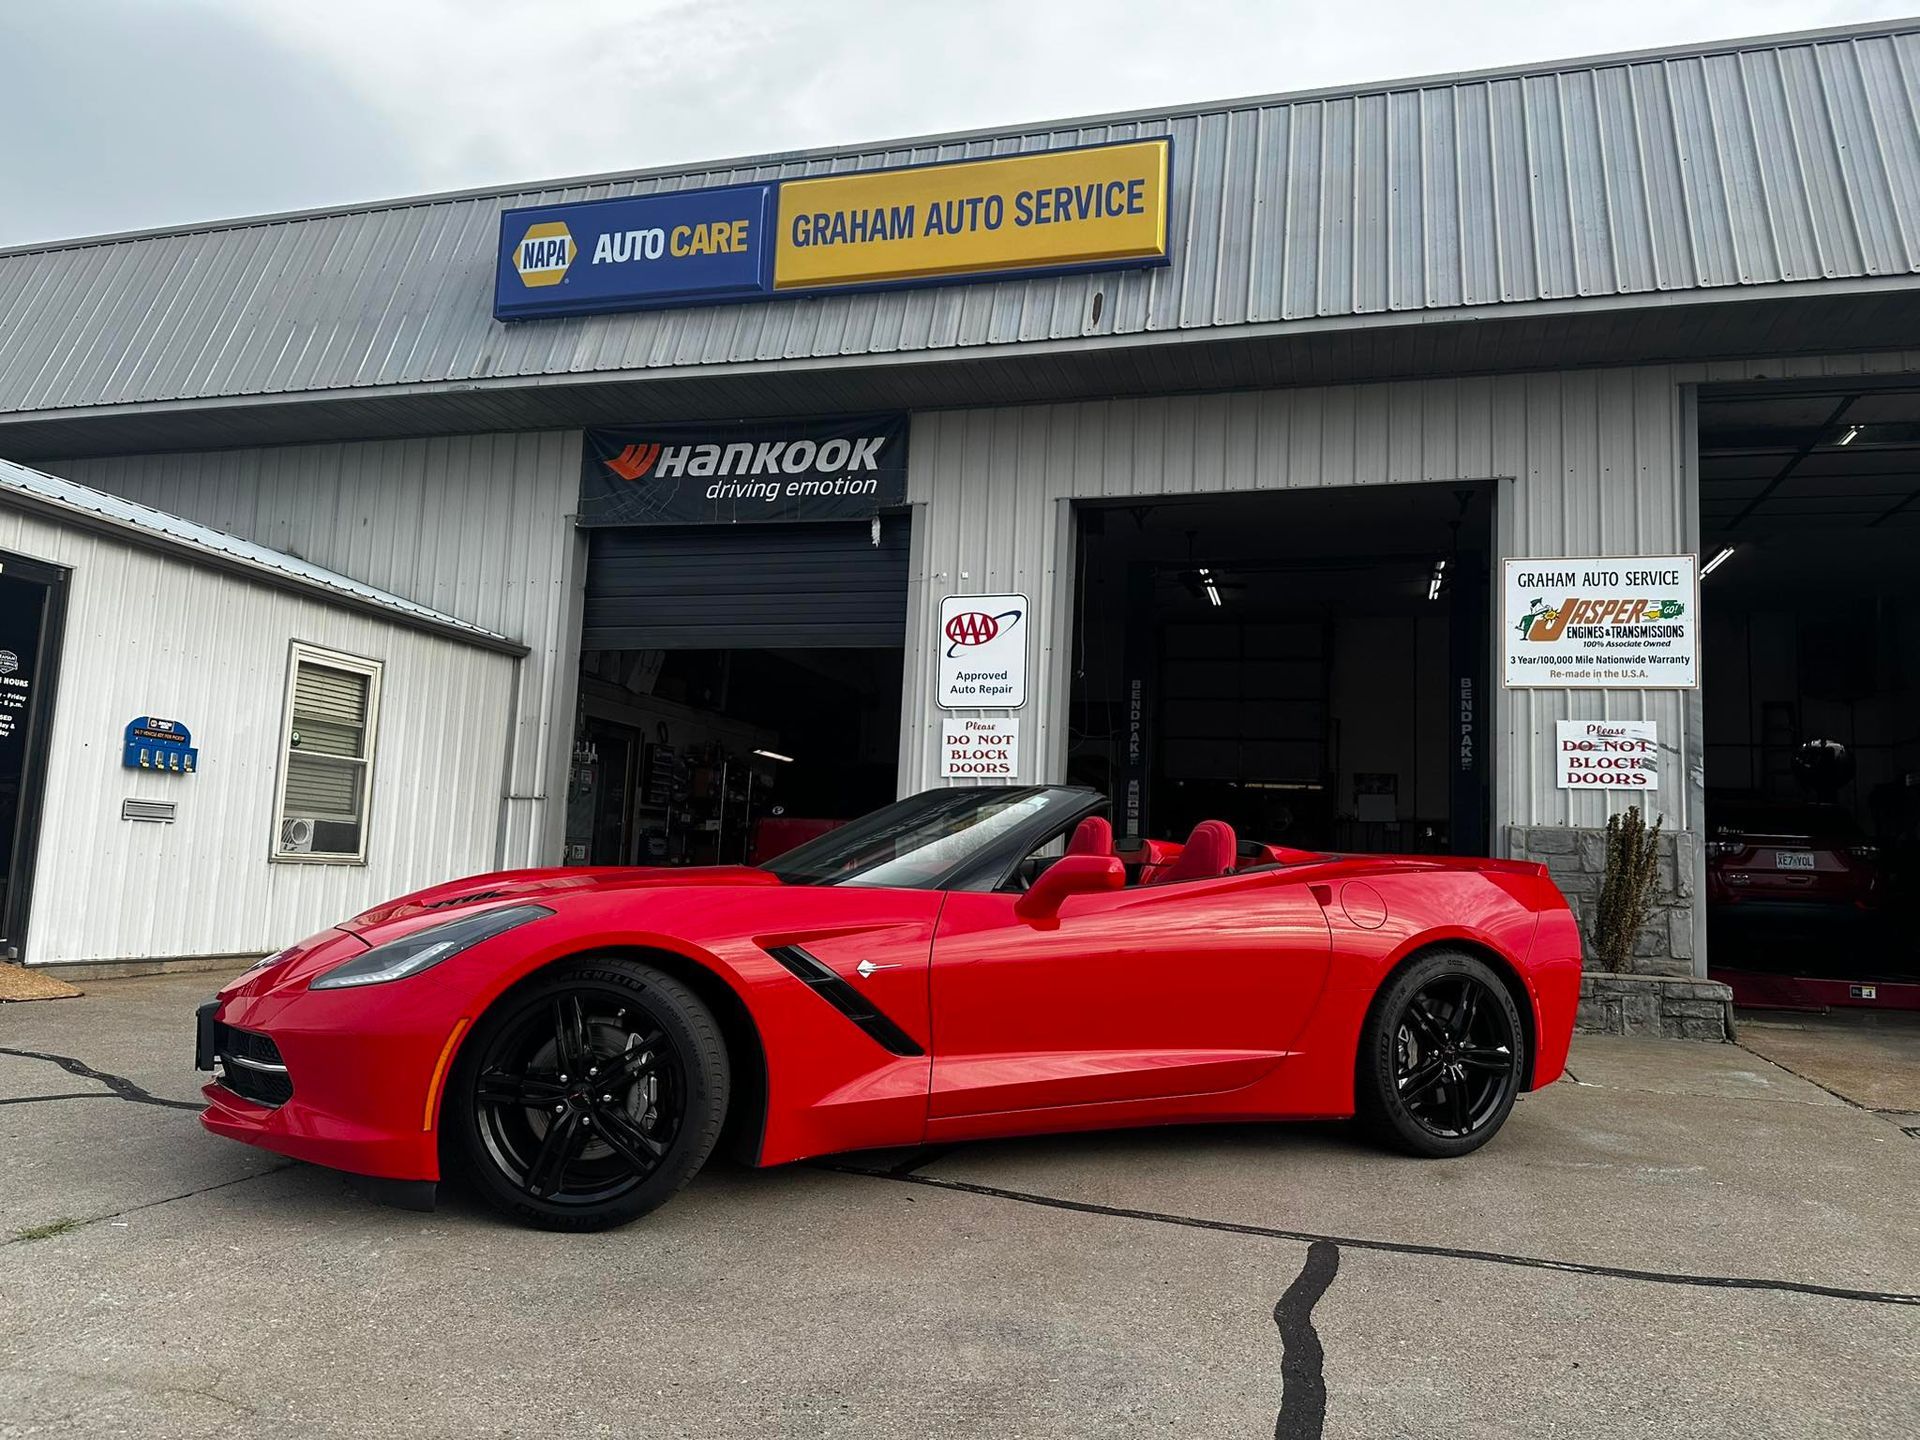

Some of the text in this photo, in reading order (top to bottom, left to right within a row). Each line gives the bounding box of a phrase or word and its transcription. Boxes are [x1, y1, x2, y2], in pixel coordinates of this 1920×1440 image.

[791, 179, 1146, 249] GRAHAM AUTO SERVICE
[592, 219, 748, 265] AUTO CARE
[522, 239, 570, 271] NAPA
[705, 476, 878, 502] driving emotion
[1517, 570, 1680, 587] GRAHAM AUTO SERVICE
[1663, 604, 1679, 615] GO!
[1528, 598, 1649, 642] JASPER
[950, 612, 994, 645] AAA
[1605, 640, 1642, 648] Associate
[1643, 640, 1672, 648] Owned
[1510, 655, 1690, 665] 3 Year/100,000 Mile Nationwide Warranty
[956, 671, 1008, 682] Approved
[1550, 670, 1648, 678] Re-made in the U.S.A.
[4, 677, 29, 688] HOURS
[950, 684, 1013, 696] Auto Repair
[7, 692, 27, 702] Friday
[965, 721, 996, 730] Please
[1586, 724, 1626, 735] Please
[946, 735, 1015, 745] DO NOT
[1562, 741, 1647, 752] DO NOT
[951, 750, 1008, 760] BLOCK
[949, 763, 1010, 773] DOORS
[1569, 757, 1642, 769] BLOCK
[1567, 773, 1647, 785] DOORS
[1777, 855, 1793, 866] XE7
[560, 970, 643, 992] MICHELIN
